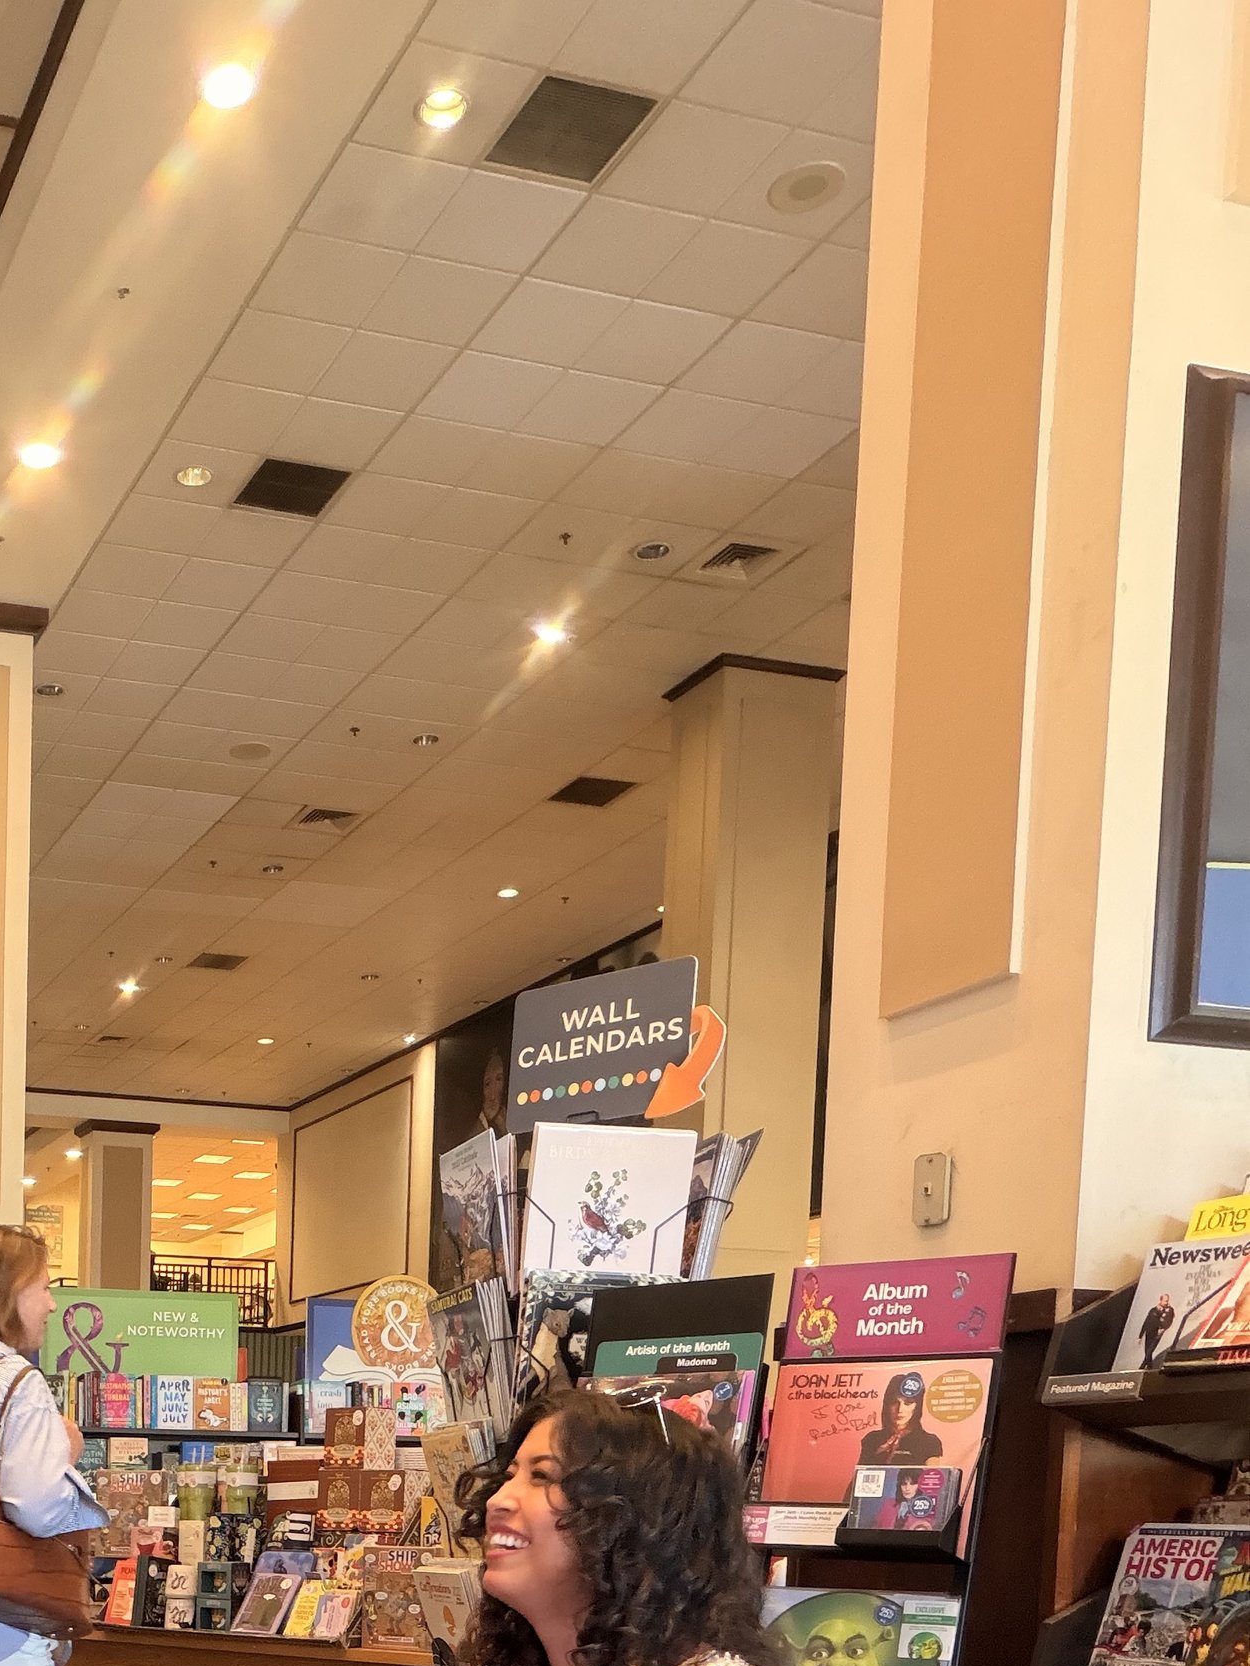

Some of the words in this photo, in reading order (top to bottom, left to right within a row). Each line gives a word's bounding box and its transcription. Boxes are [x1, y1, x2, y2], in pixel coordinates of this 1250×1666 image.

[562, 998, 640, 1033] WALL
[518, 1017, 684, 1069] CALENDARS
[1150, 1242, 1250, 1267] Newswee
[380, 1285, 418, 1297] BOOKS
[458, 1287, 472, 1304] CATS
[863, 1283, 928, 1301] Album
[362, 1292, 379, 1325] MORE
[869, 1303, 883, 1316] of
[886, 1303, 912, 1314] the
[152, 1311, 186, 1322] NEW
[190, 1311, 199, 1323] &
[127, 1324, 225, 1340] NOTEWORTHY
[856, 1316, 924, 1336] Month
[361, 1330, 377, 1359] READ
[625, 1345, 657, 1356] Artist
[660, 1344, 671, 1353] of
[673, 1343, 692, 1352] the
[694, 1341, 730, 1352] Month
[677, 1358, 718, 1367] Madonna
[789, 1374, 829, 1388] JOAN
[832, 1373, 863, 1387] JETT
[1050, 1381, 1090, 1394] Featured
[1091, 1379, 1135, 1392] Magazine
[163, 1392, 186, 1402] MAY
[320, 1389, 342, 1398] crash
[814, 1389, 878, 1399] blackhearts
[161, 1402, 189, 1413] JUNE
[162, 1413, 188, 1424] JULY
[120, 1473, 147, 1483] SHIP
[1131, 1538, 1218, 1558] AMERIC
[388, 1550, 418, 1562] SHIP
